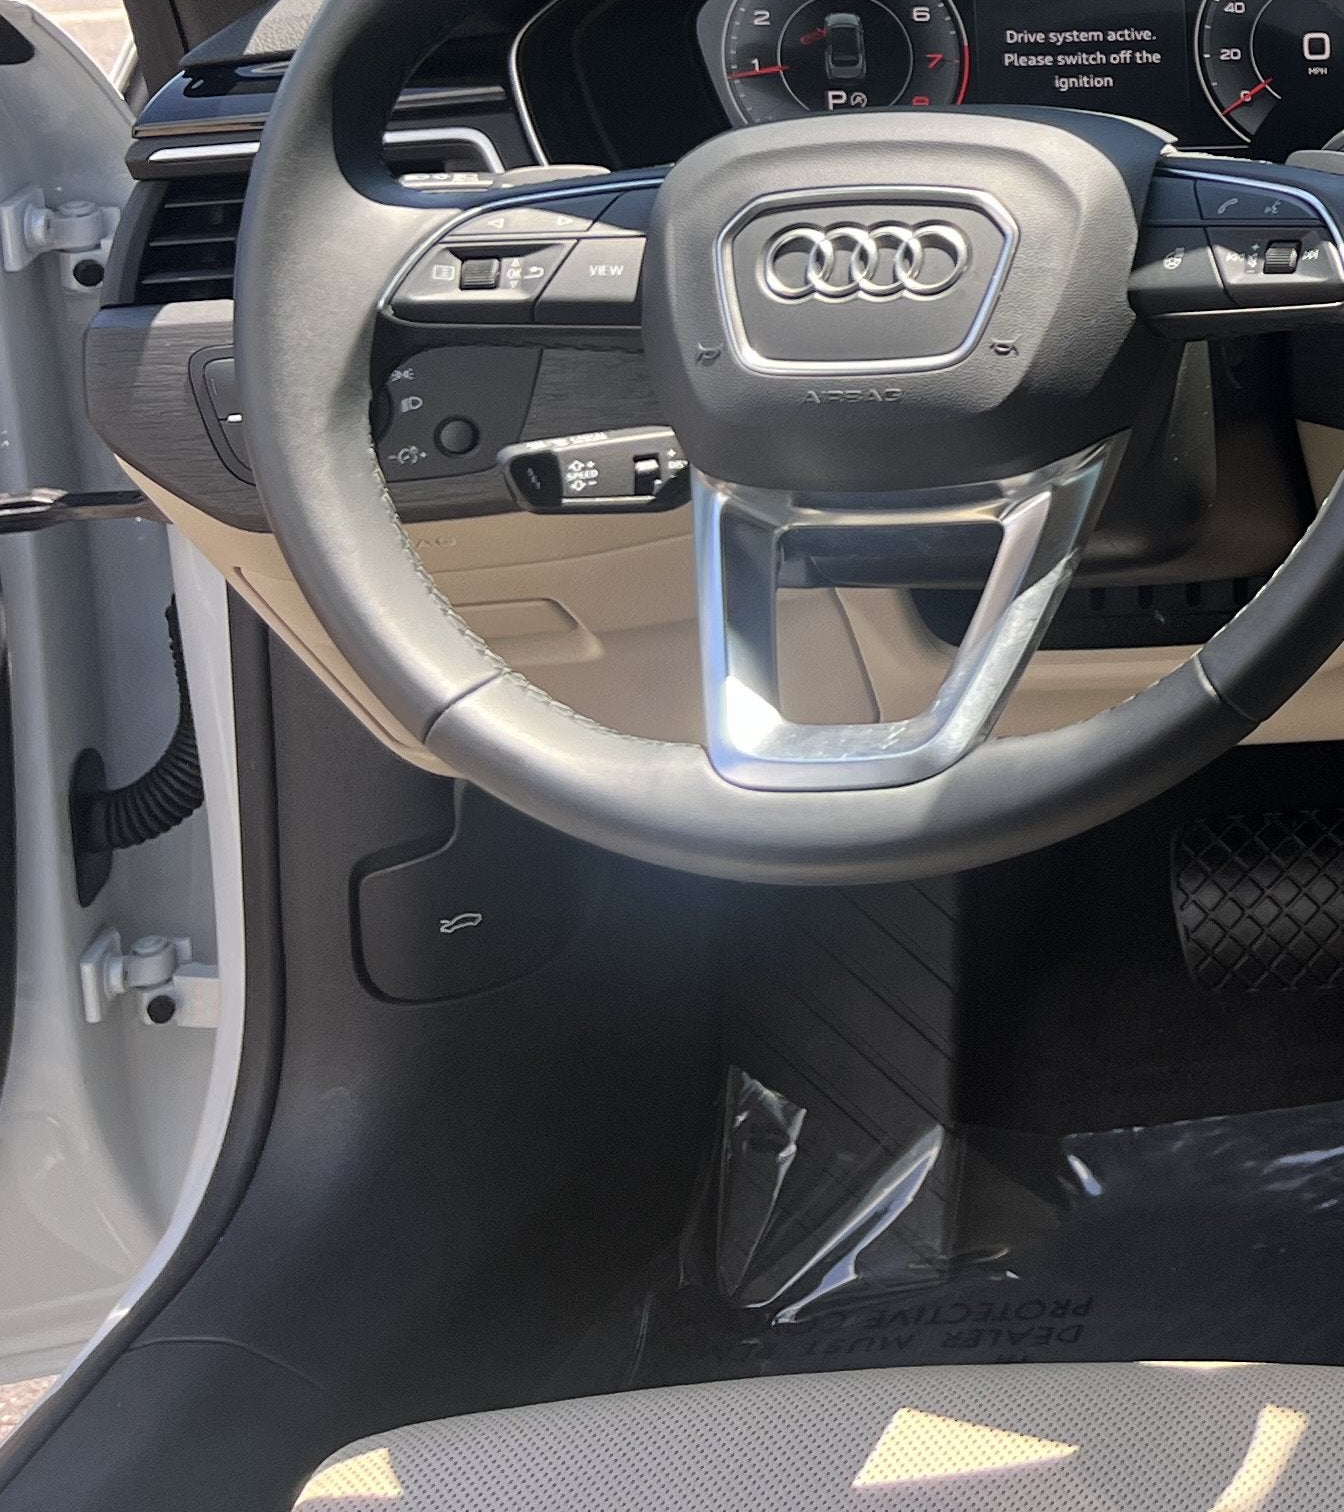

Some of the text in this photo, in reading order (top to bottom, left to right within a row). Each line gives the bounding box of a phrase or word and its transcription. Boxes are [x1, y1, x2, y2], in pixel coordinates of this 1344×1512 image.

[911, 6, 931, 22] 6
[1223, 1, 1246, 15] 40
[752, 10, 772, 26] 2
[1006, 28, 1157, 48] Drive system active.
[1302, 31, 1332, 61] 0
[926, 54, 944, 70] 7
[1004, 50, 1162, 67] Please switch off the
[1219, 48, 1242, 61] 20
[1308, 67, 1328, 76] MPH
[1054, 73, 1114, 92] ignition
[827, 91, 847, 110] P
[507, 268, 523, 279] OK
[589, 264, 624, 277] VIEW
